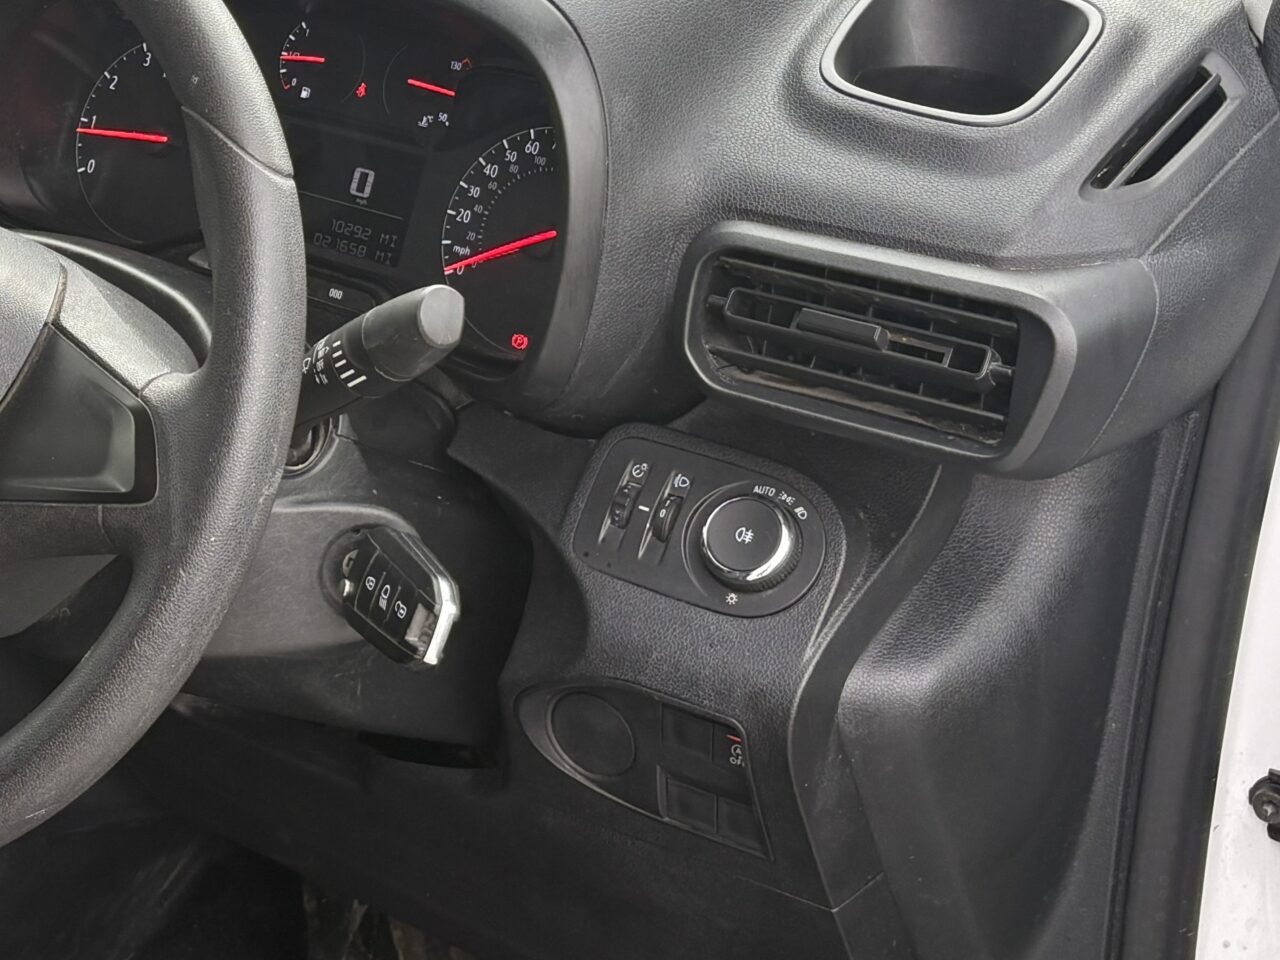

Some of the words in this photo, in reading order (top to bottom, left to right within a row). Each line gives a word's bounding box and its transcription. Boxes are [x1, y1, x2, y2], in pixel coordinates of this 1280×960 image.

[142, 52, 152, 67] 3
[450, 60, 462, 71] 130
[108, 75, 119, 90] 2
[89, 115, 97, 129] 1
[437, 112, 448, 123] 50
[524, 140, 540, 155] 60
[504, 149, 518, 163] 50
[533, 155, 546, 167] 100
[86, 159, 96, 174] 0
[483, 164, 499, 178] 40
[508, 164, 519, 174] 80
[349, 167, 375, 198] 0
[487, 181, 498, 190] 60
[467, 185, 481, 198] 30
[473, 203, 484, 214] 40
[455, 208, 471, 223] 20
[331, 219, 372, 241] 10292
[380, 232, 398, 248] MI
[465, 231, 476, 241] 20
[452, 243, 471, 256] mph
[752, 485, 776, 497] AUTO
